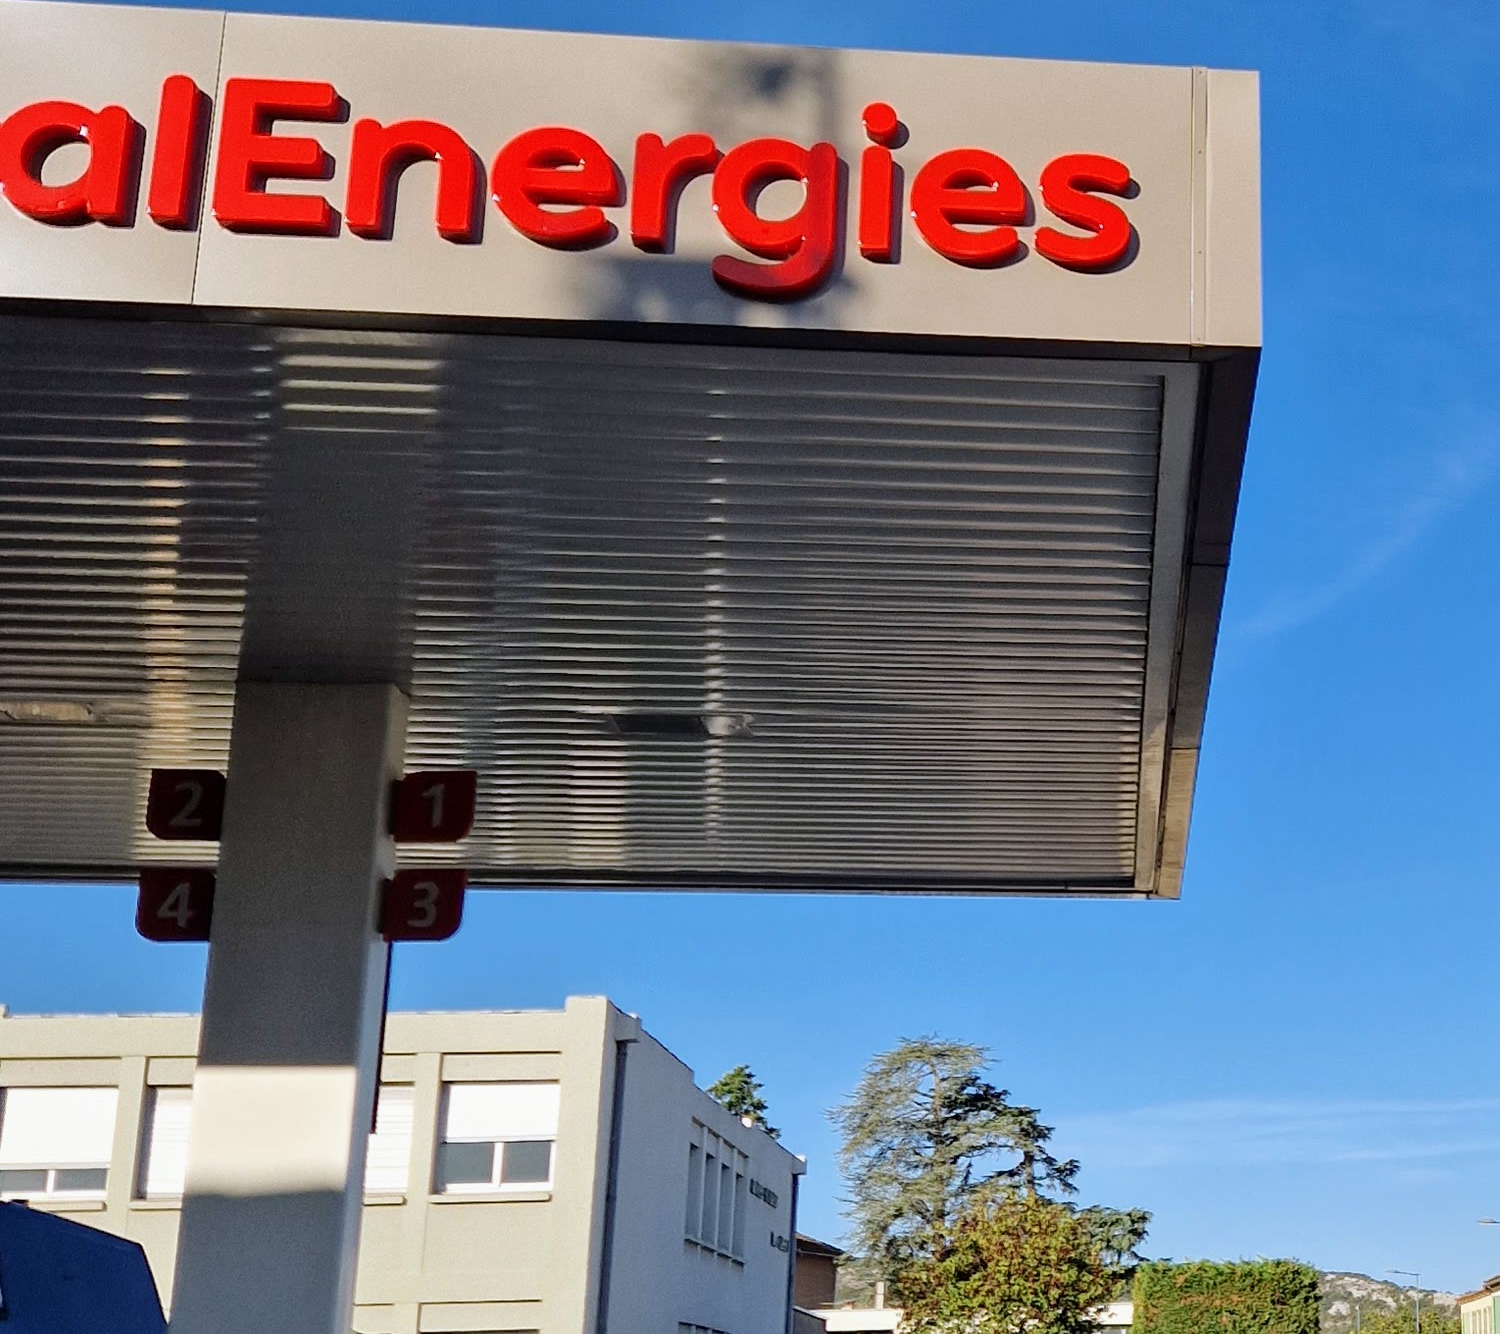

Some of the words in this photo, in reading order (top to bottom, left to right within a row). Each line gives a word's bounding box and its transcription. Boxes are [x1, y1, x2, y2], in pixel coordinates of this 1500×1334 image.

[0, 73, 1135, 301] alEnergies
[170, 780, 201, 828] 2
[422, 782, 446, 828] 1
[157, 881, 193, 929] 4
[406, 880, 440, 928] 3
